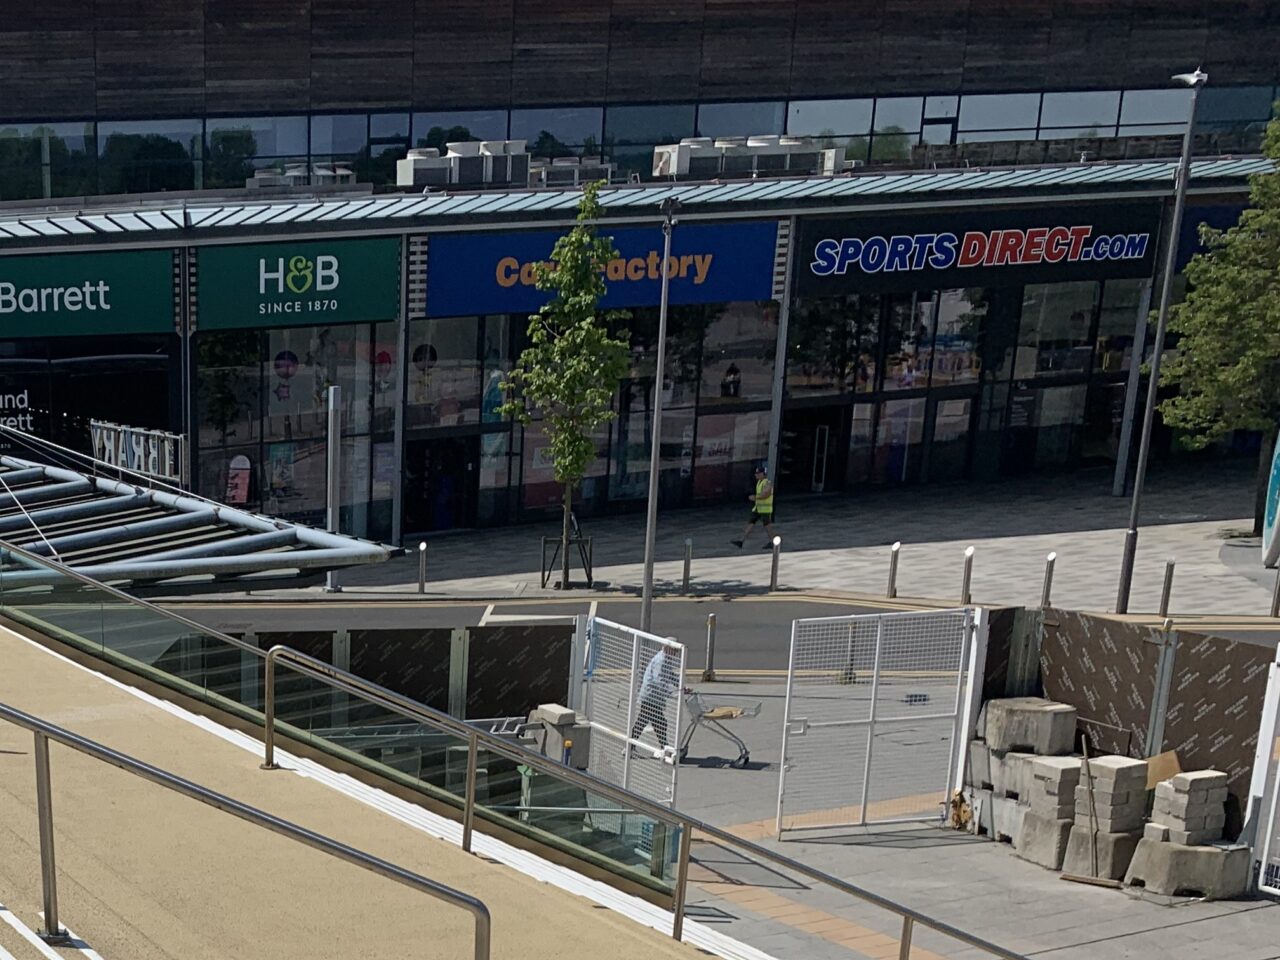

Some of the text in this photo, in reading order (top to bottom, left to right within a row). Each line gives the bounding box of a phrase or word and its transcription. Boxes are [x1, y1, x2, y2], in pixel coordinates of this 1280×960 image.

[496, 257, 568, 287] Ca
[259, 299, 338, 314] SINCE 1870
